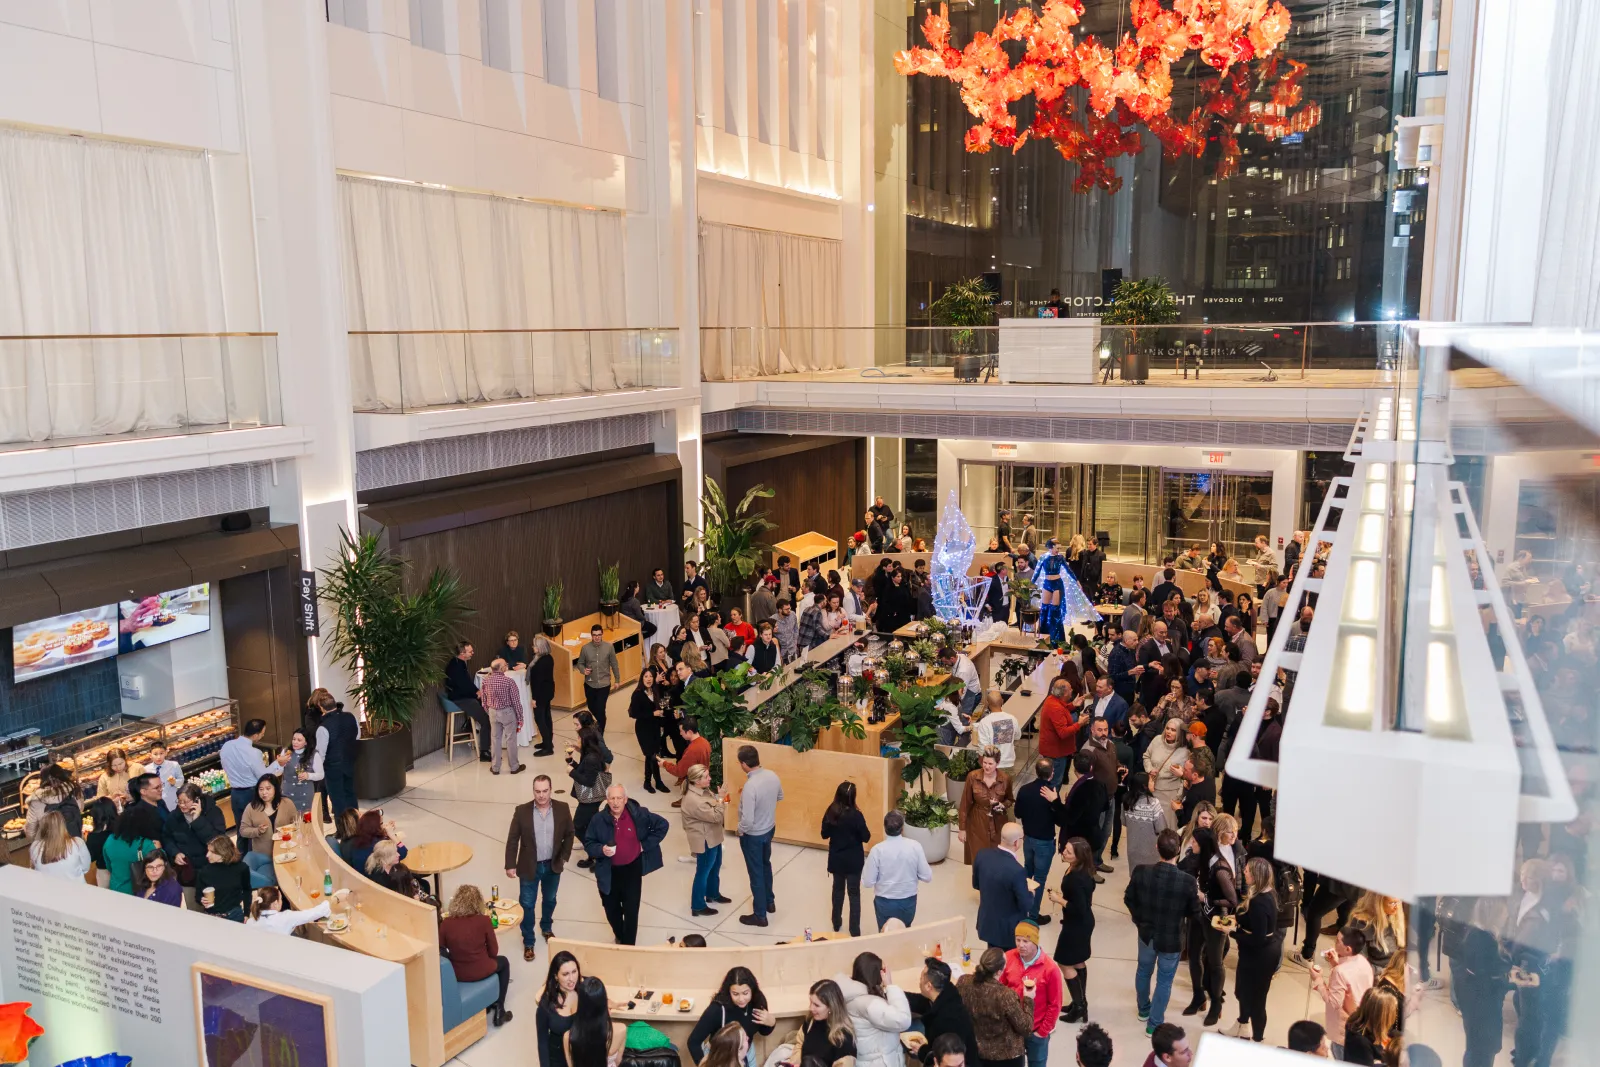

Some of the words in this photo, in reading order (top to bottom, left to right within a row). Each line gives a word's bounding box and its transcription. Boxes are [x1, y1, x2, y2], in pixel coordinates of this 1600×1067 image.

[1209, 452, 1224, 463] EXIT
[301, 578, 312, 601] Day
[304, 604, 315, 631] Shift
[11, 908, 22, 916] Dale
[26, 912, 45, 924] Chihuly
[64, 923, 89, 935] American
[92, 931, 106, 940] artist
[110, 936, 121, 945] who
[124, 940, 155, 954] transforms
[13, 919, 30, 928] spaces
[32, 924, 43, 932] with
[45, 928, 77, 942] experiments
[14, 937, 42, 949] large-scale
[48, 947, 80, 961] architectural
[85, 958, 119, 973] installations
[124, 970, 143, 980] around
[148, 976, 158, 984] the
[16, 946, 30, 955] world
[121, 978, 138, 987] studio
[143, 985, 159, 994] glass
[17, 965, 40, 977] including
[65, 942, 82, 952] known
[111, 956, 142, 970] exhibitions
[146, 965, 157, 974] and
[19, 983, 41, 994] museum
[42, 990, 70, 1003] collections
[48, 964, 67, 976] Chihuly
[70, 972, 86, 981] works
[111, 984, 129, 996] variety
[142, 994, 160, 1004] media
[65, 988, 78, 997] work
[86, 996, 109, 1007] included
[119, 1006, 133, 1014] more
[135, 1011, 148, 1020] than
[150, 1014, 161, 1024] 200
